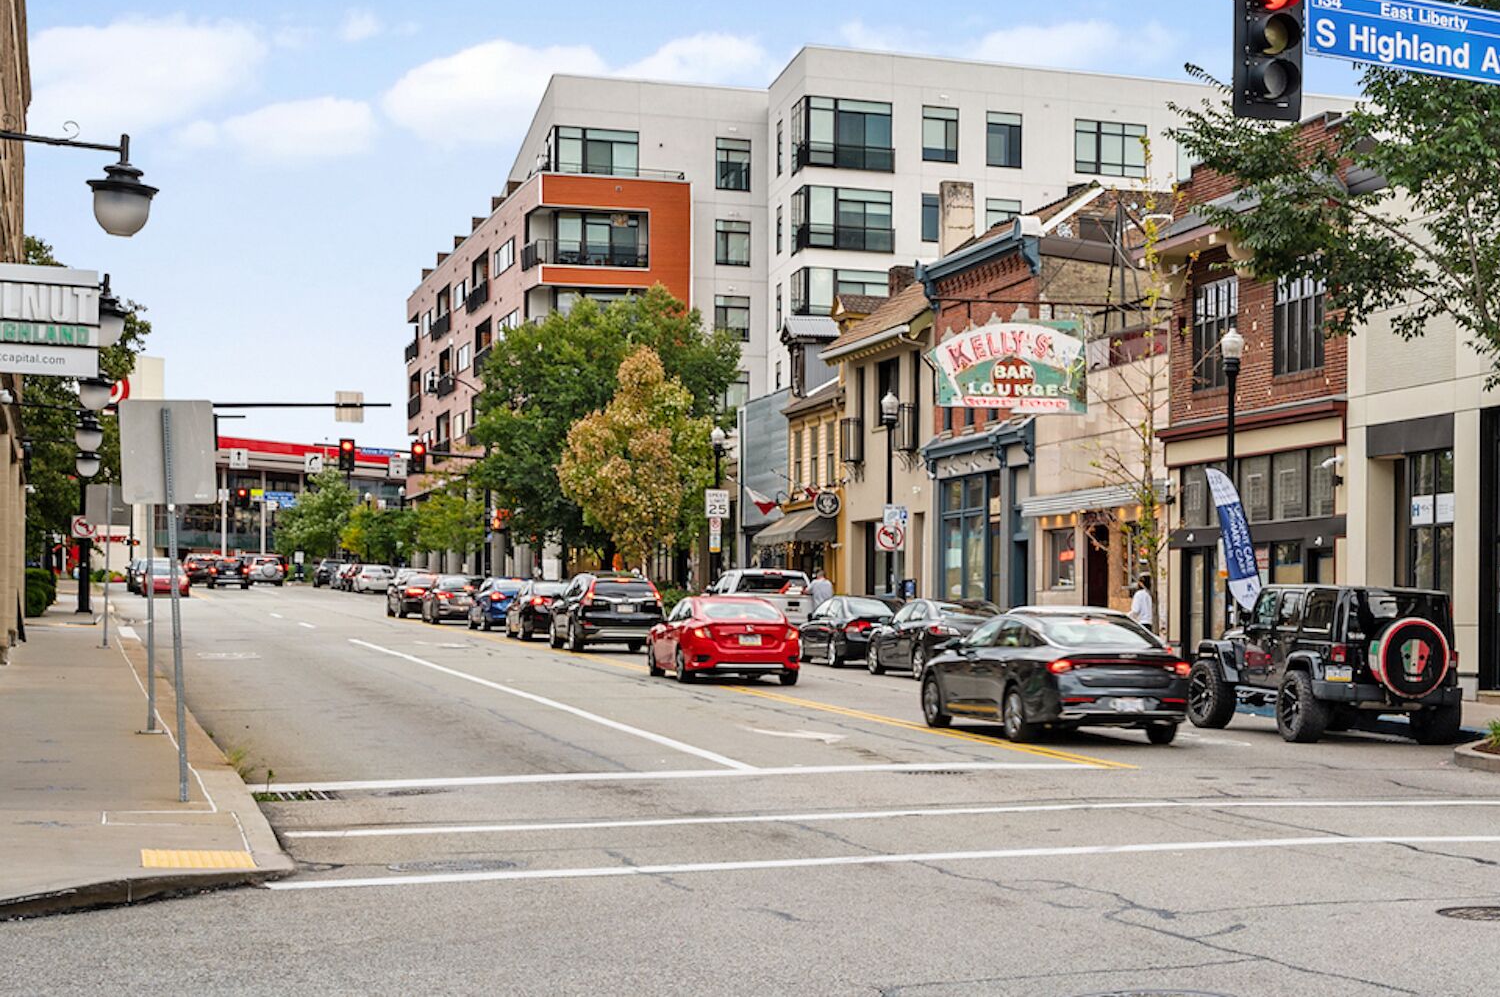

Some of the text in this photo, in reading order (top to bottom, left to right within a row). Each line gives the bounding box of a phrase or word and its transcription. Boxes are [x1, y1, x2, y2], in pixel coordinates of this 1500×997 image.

[1380, 2, 1468, 33] East Liberty
[1315, 17, 1337, 48] S
[1350, 23, 1470, 70] Highland
[0, 282, 92, 322] LNUT
[945, 330, 1052, 373] KELLY'S
[994, 365, 1033, 379] BAR
[968, 381, 1059, 396] LOUNGE
[708, 504, 727, 514] 25
